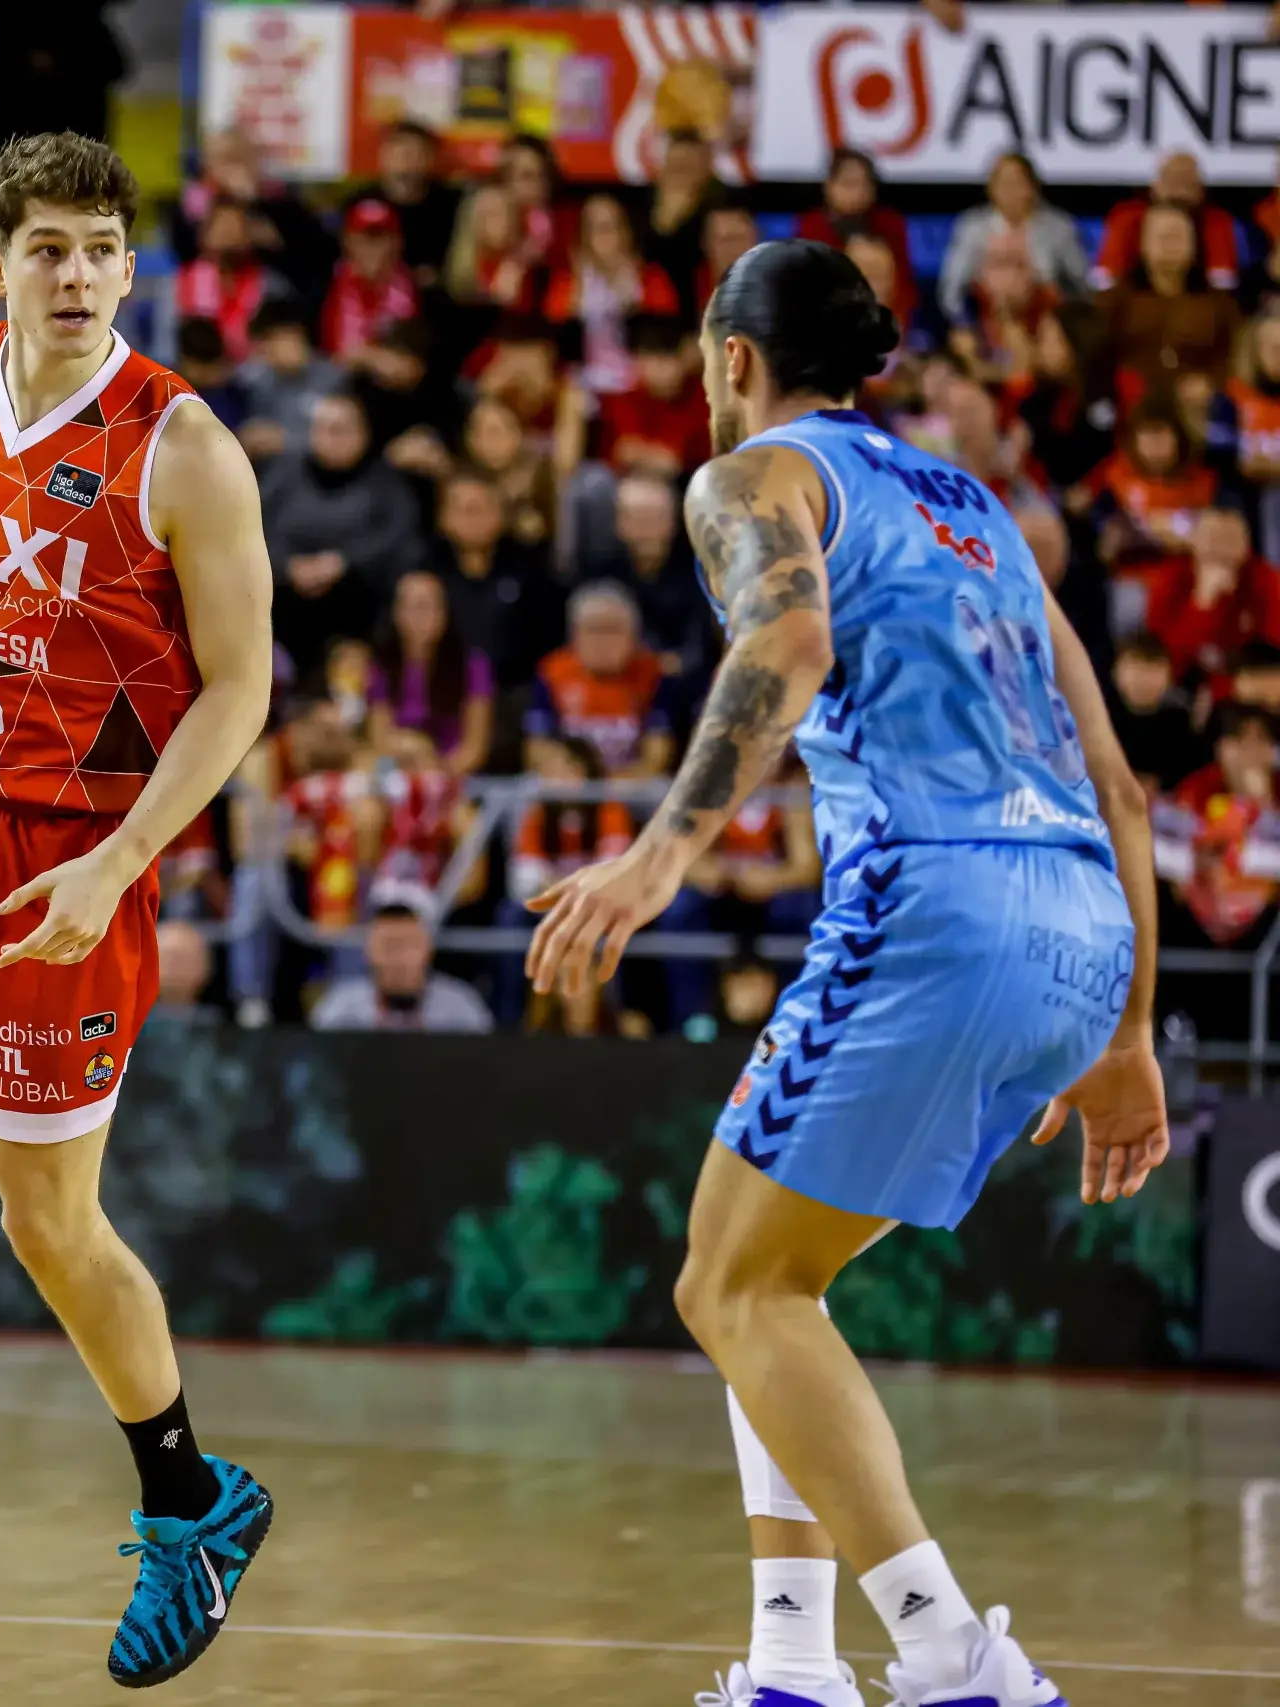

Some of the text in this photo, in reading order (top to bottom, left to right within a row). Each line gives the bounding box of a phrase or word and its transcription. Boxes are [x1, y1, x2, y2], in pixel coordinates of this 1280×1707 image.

[945, 36, 1280, 147] AIGNE
[55, 473, 74, 487] liga
[51, 484, 92, 504] endesa
[83, 1023, 107, 1038] acb
